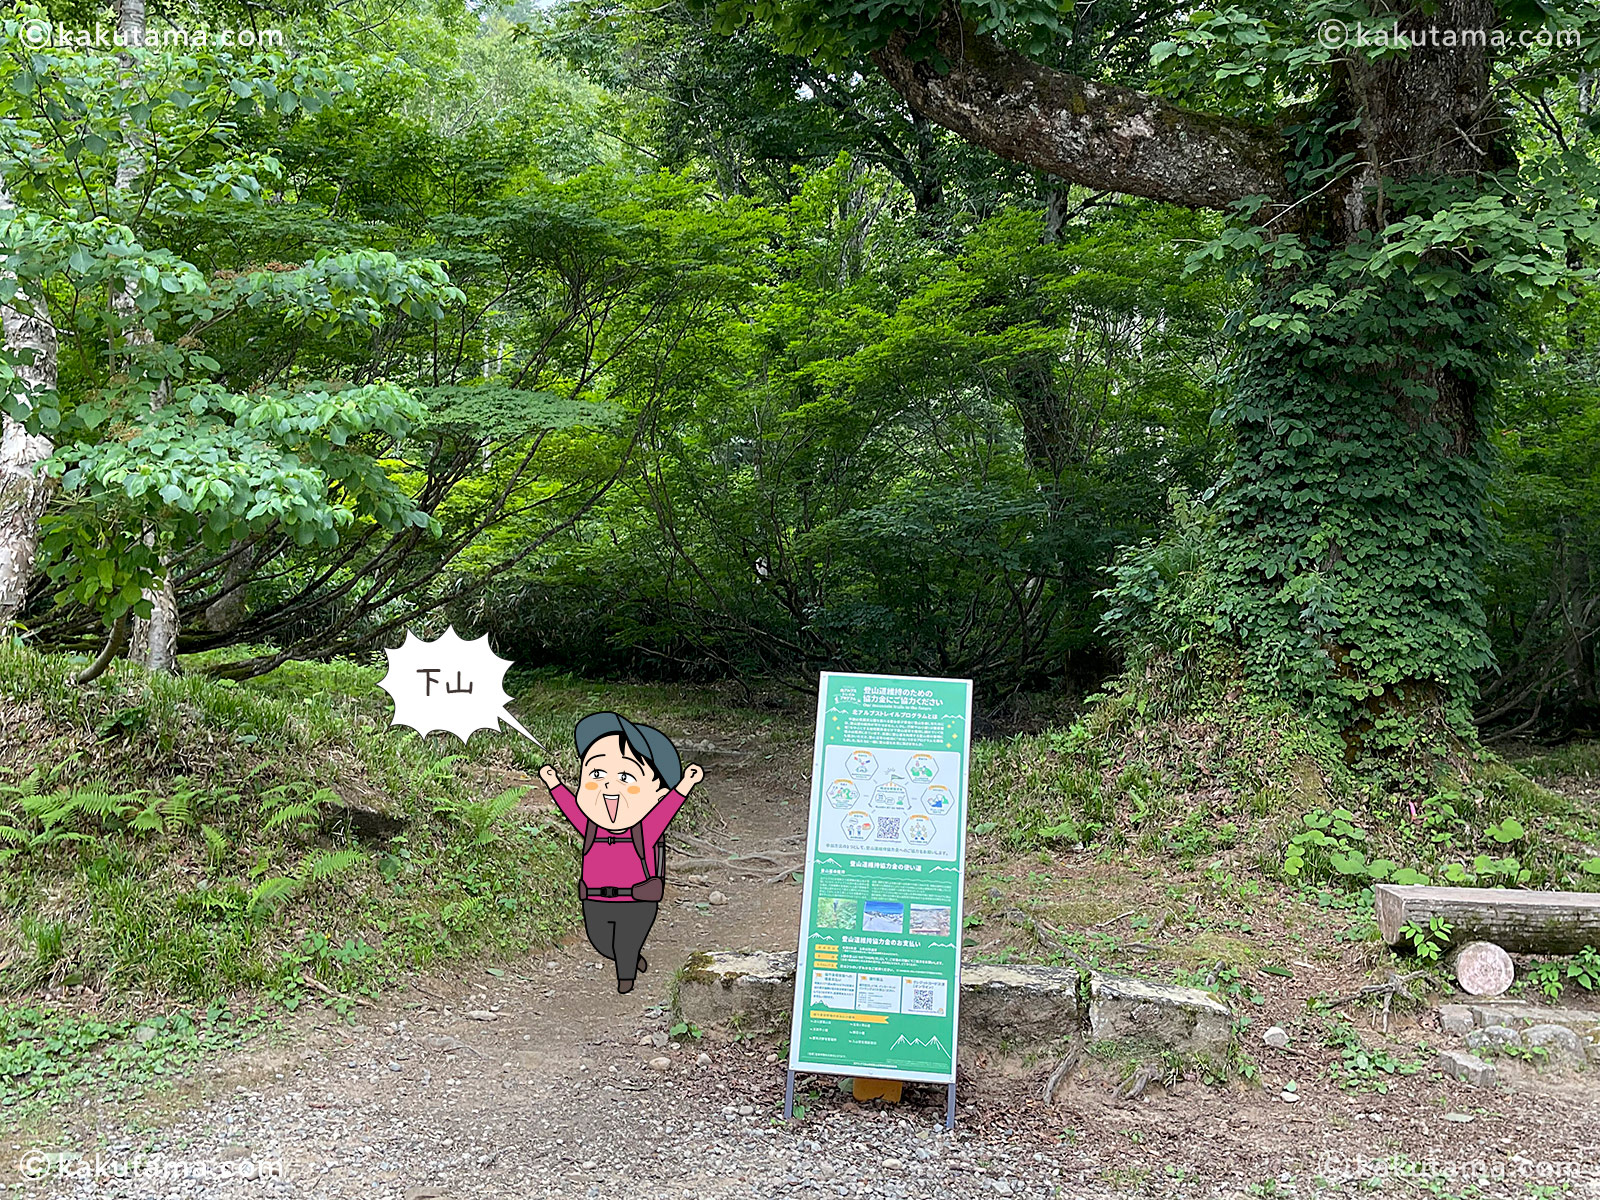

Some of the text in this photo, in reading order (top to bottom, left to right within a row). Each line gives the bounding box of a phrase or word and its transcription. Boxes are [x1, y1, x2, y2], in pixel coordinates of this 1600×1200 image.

[863, 686, 933, 698] 登山道維持のための
[862, 694, 944, 707] 協力金にご協力ください
[852, 709, 938, 720] 北アルプストレイルプログラムとは
[849, 860, 922, 872] 登山道維持協力金の使い道
[841, 935, 922, 947] 登山道維持協力金のお支払い
